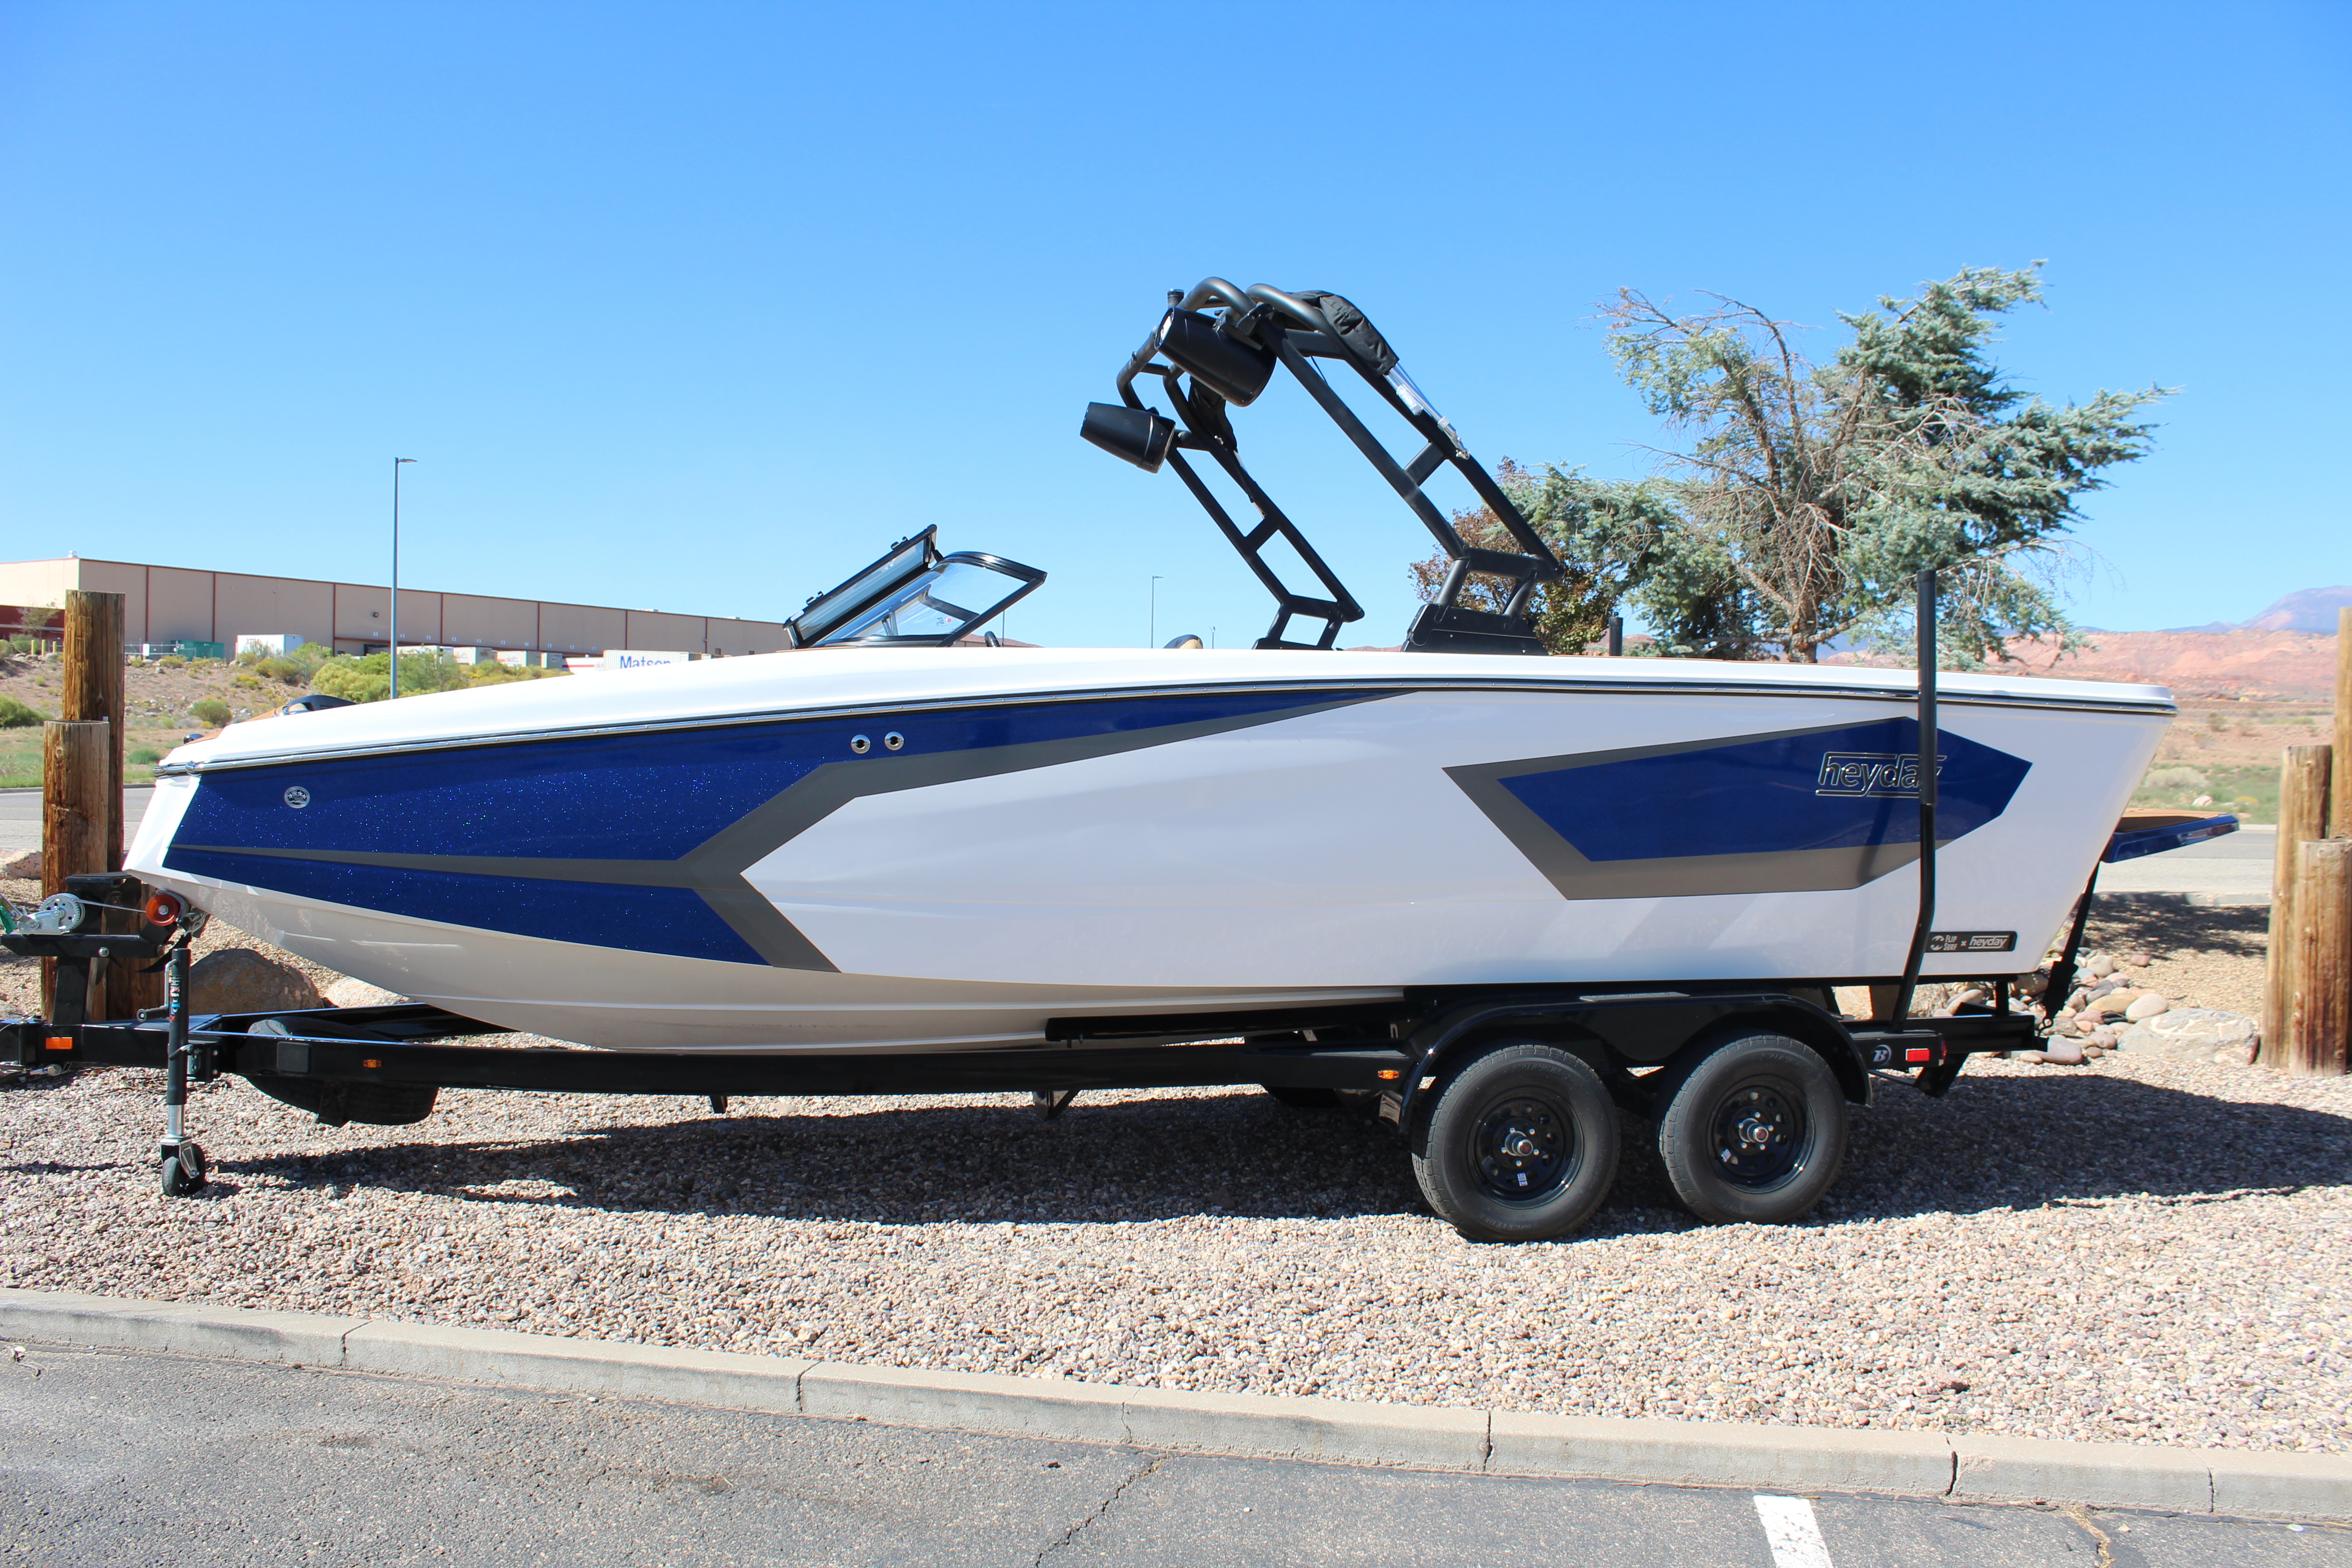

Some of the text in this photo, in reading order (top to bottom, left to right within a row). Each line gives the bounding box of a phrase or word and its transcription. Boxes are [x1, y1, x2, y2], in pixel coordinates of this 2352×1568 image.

[620, 656, 671, 669] Mats
[1815, 752, 1947, 798] heyda
[1945, 935, 1957, 943] FLIP
[1968, 936, 2009, 949] heyday
